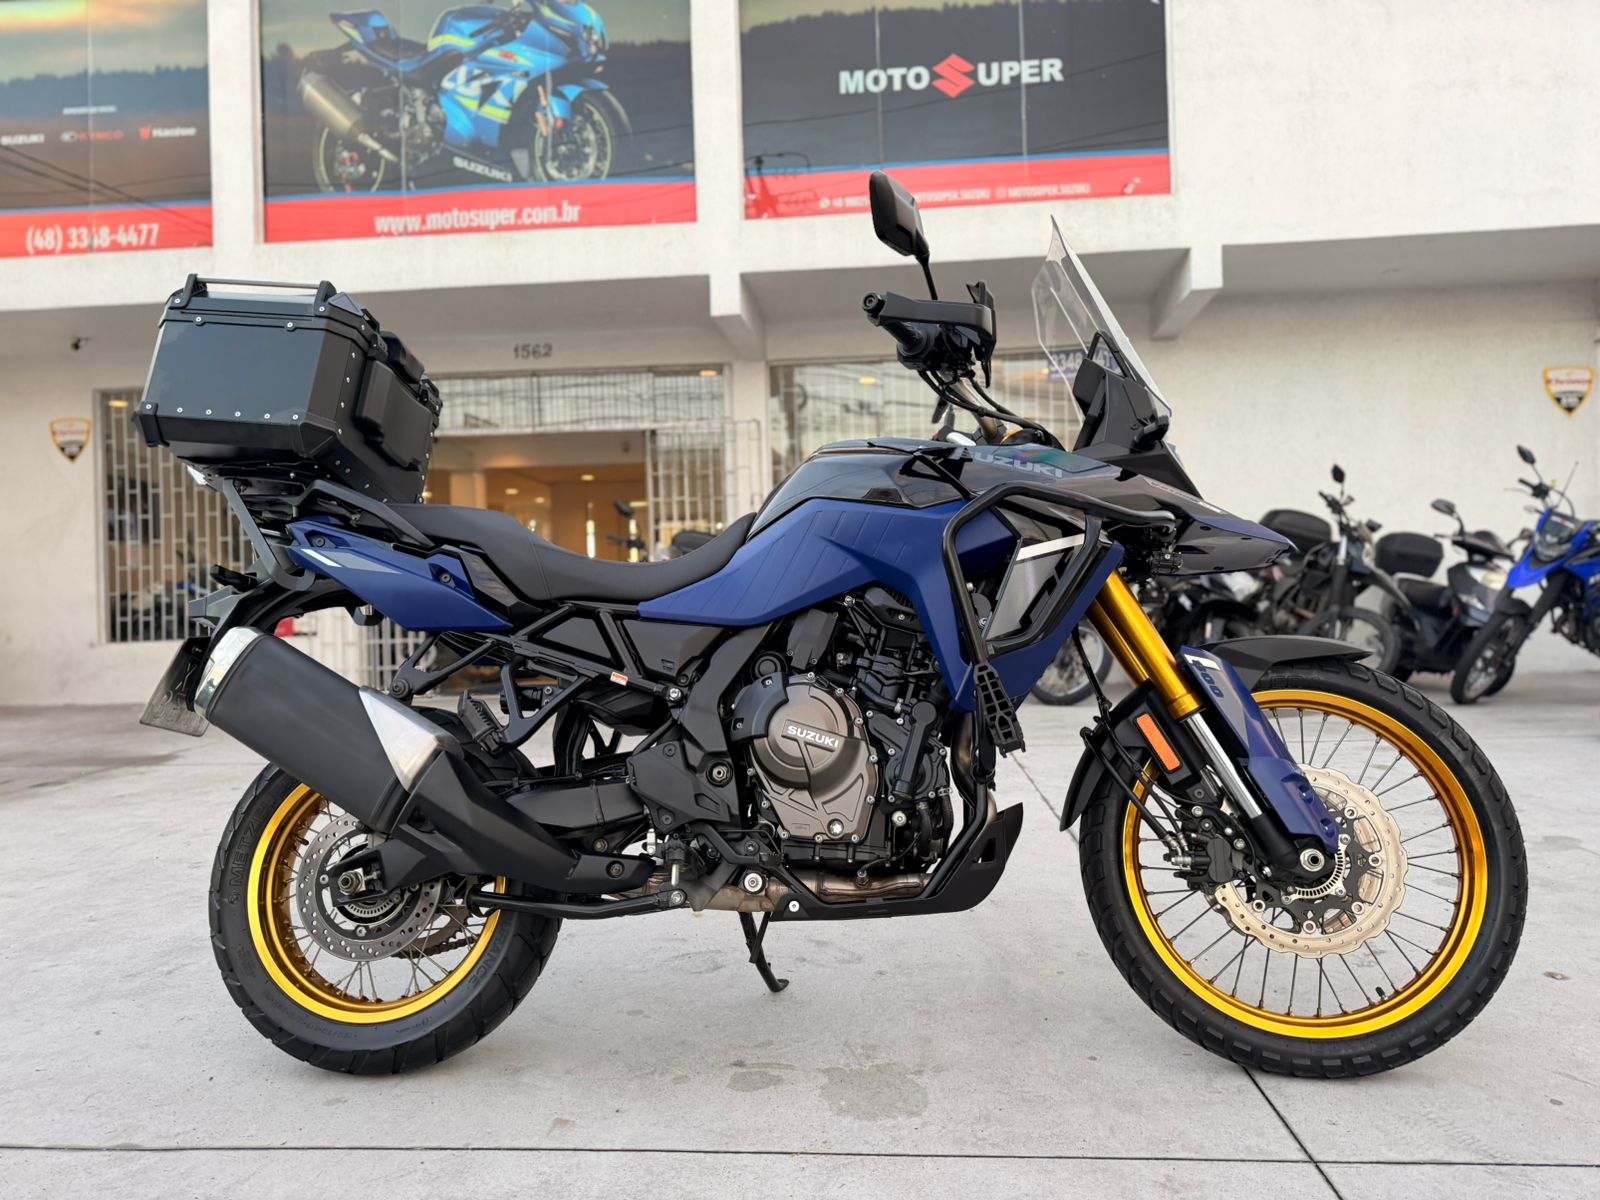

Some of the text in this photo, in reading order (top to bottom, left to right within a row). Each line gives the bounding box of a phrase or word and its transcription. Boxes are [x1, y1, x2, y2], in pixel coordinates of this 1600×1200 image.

[838, 66, 931, 95] MOTO
[452, 155, 513, 184] SUZUKI
[374, 200, 582, 234] www.motosuper.com.br
[25, 225, 63, 255] (48)
[513, 342, 553, 360] 1562
[964, 449, 1063, 478] UZUKI
[786, 724, 839, 749] SUZUKI
